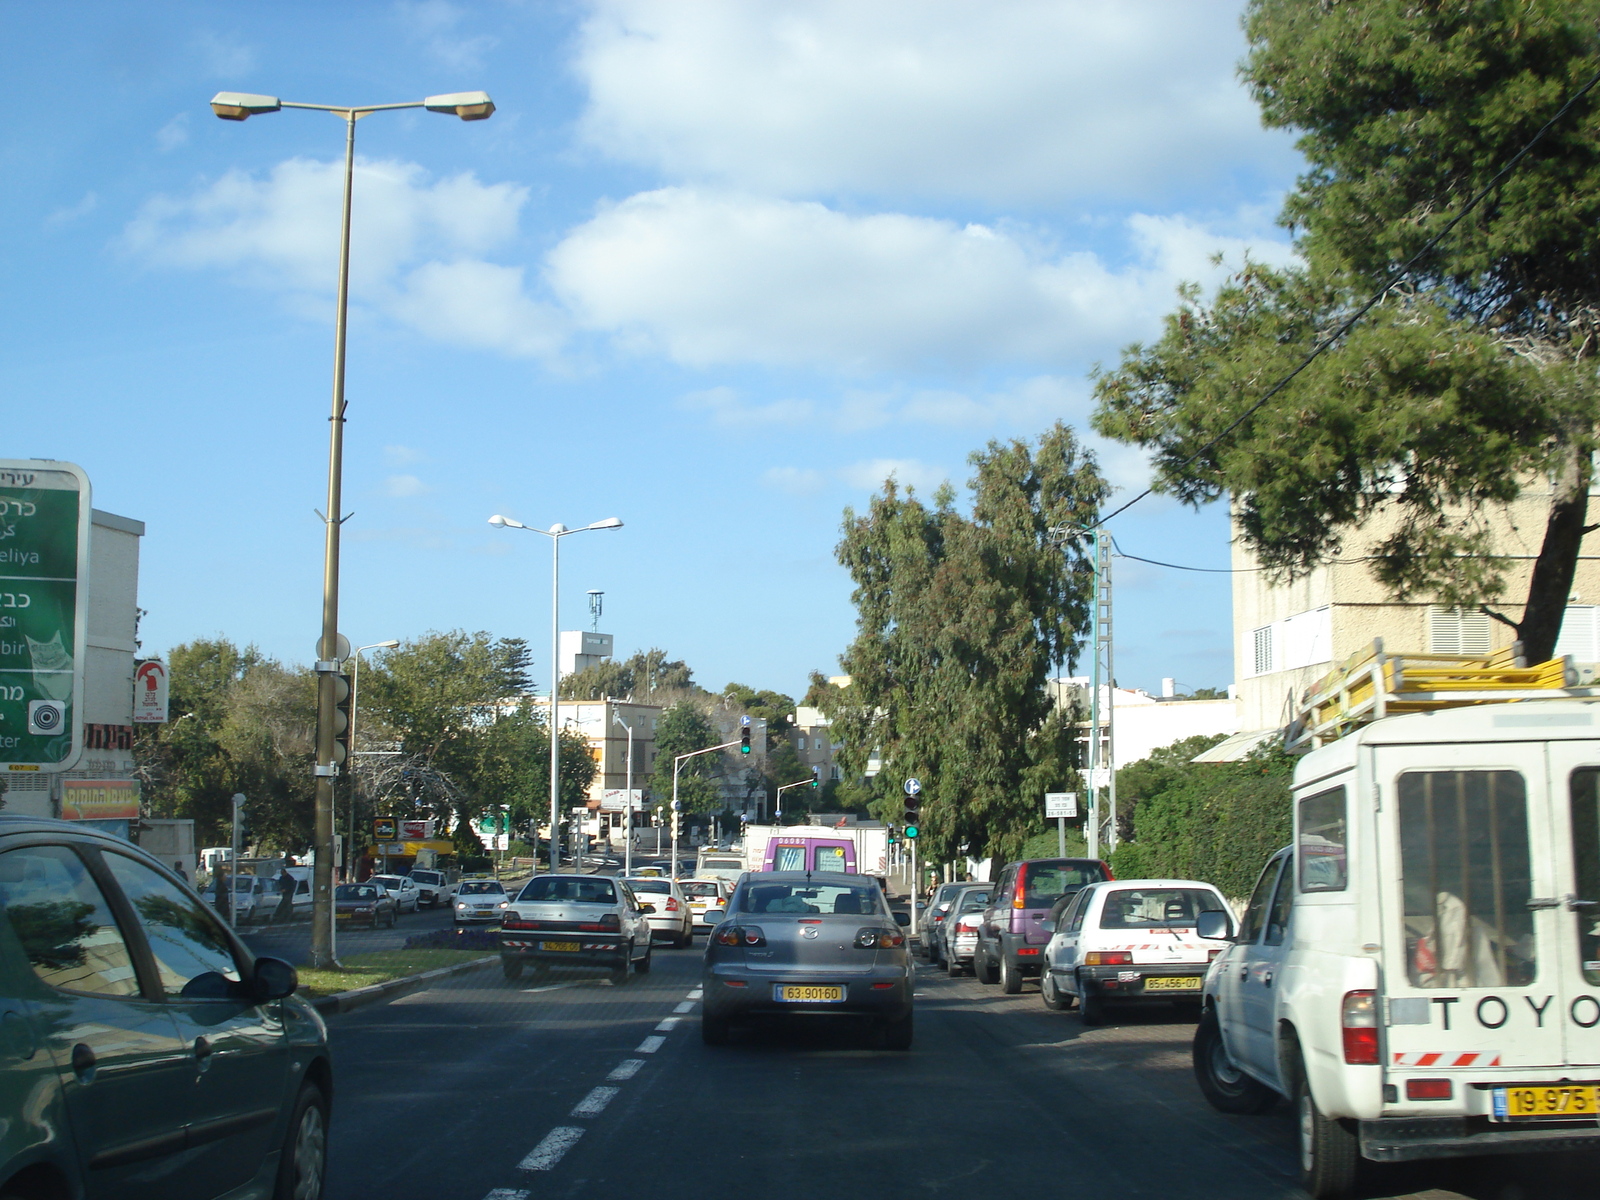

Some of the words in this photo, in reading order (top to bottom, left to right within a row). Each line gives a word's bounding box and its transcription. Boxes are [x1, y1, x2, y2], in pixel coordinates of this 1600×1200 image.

[0, 548, 40, 566] eliya
[1, 640, 25, 655] bir
[1431, 995, 1600, 1030] TOYO
